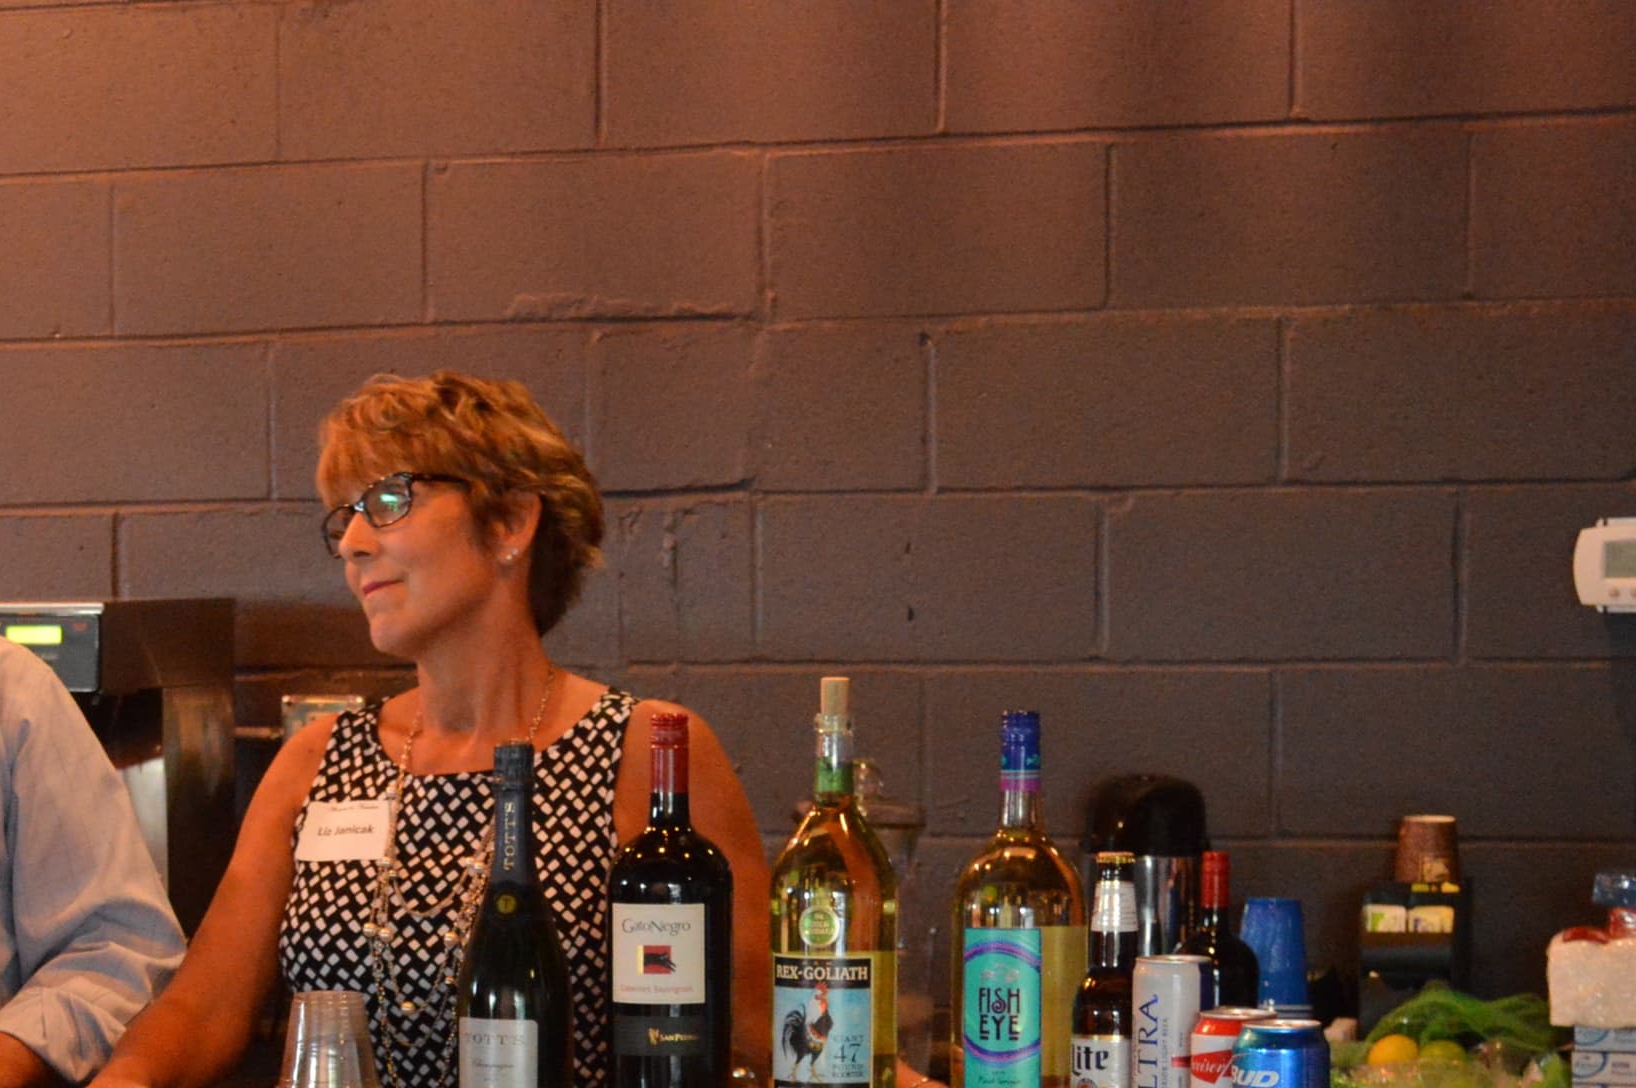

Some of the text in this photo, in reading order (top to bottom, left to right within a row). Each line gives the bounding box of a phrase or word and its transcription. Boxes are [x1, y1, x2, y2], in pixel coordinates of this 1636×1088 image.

[317, 824, 374, 837] Liz Janicak
[776, 964, 869, 981] REX-GOLIATH
[978, 987, 1021, 1014] FISH
[979, 1014, 1021, 1041] EYE
[833, 1043, 861, 1063] 47
[1071, 1044, 1110, 1077] Lite
